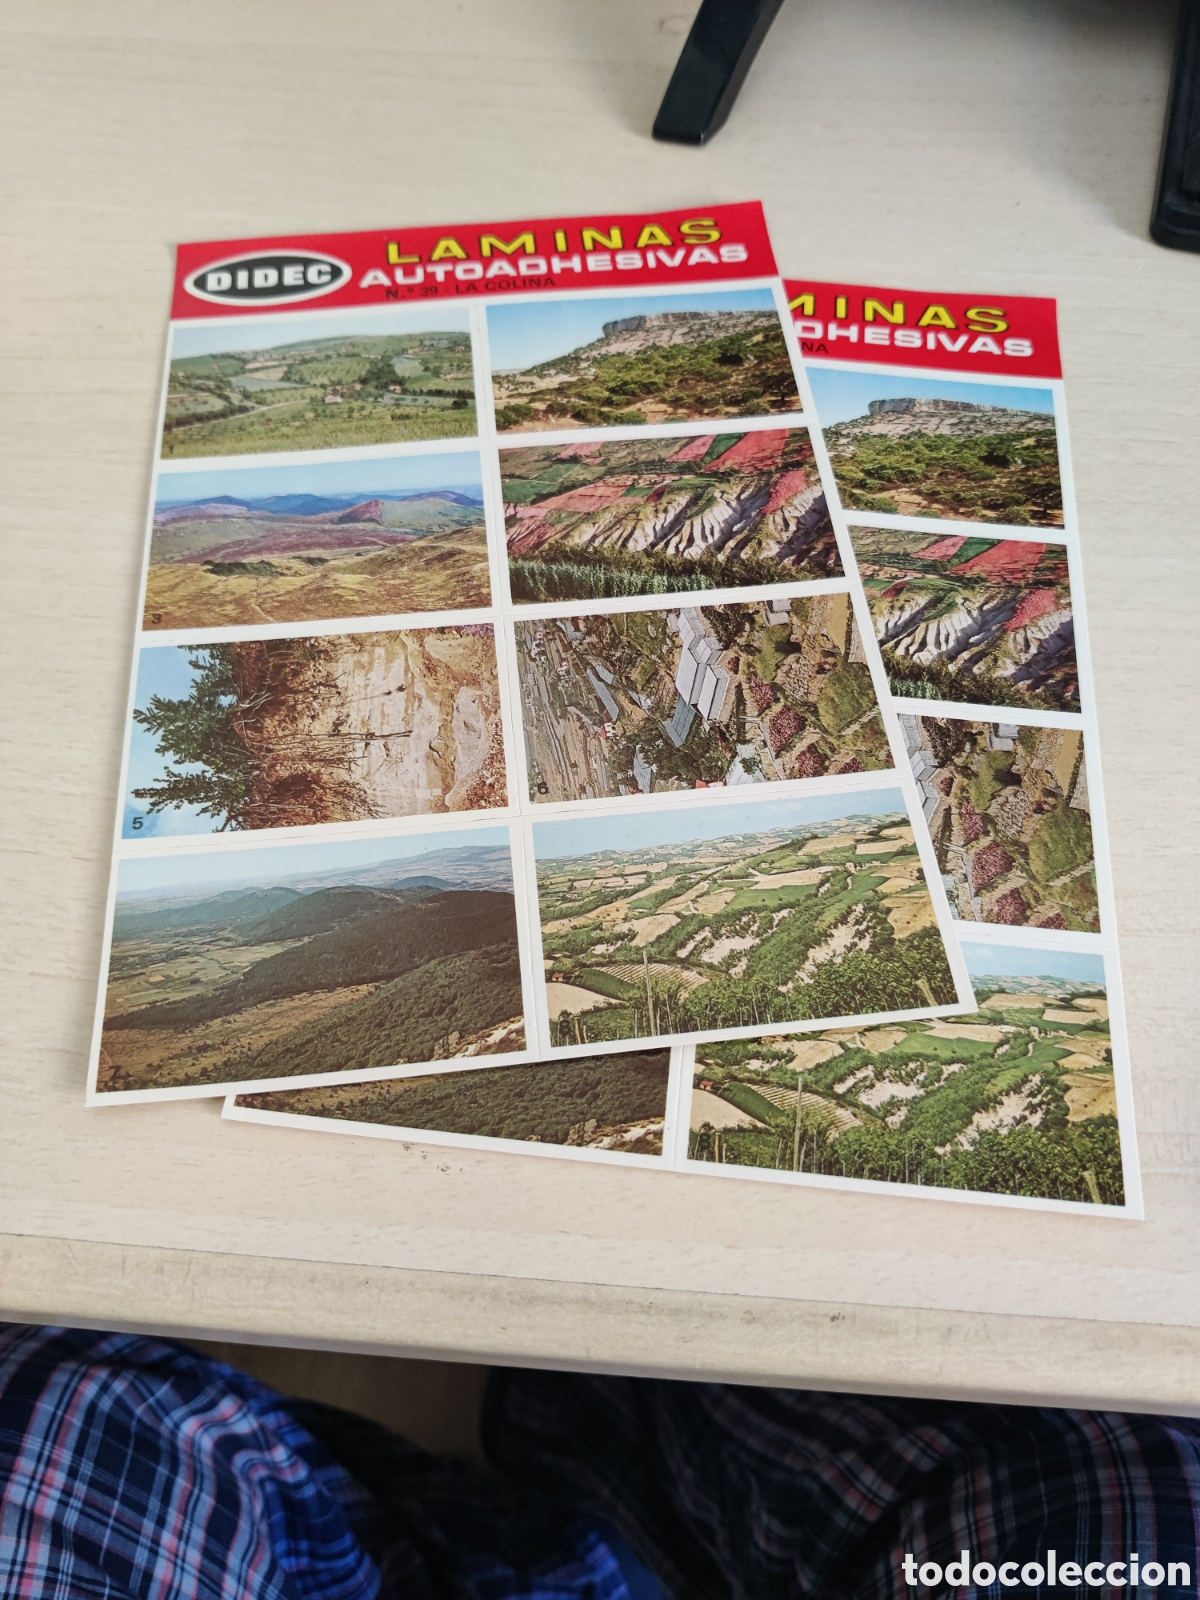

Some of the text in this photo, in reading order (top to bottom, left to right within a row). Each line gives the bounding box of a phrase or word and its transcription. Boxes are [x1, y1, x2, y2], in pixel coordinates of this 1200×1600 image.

[386, 216, 724, 265] LAMINAS
[358, 242, 749, 289] AUTOADHESIVAS
[206, 263, 333, 292] DIDEC
[420, 286, 439, 297] 39
[455, 282, 479, 294] LA
[485, 277, 556, 292] COLINA
[151, 613, 163, 625] 3
[537, 781, 549, 795] 6
[132, 816, 144, 830] 5
